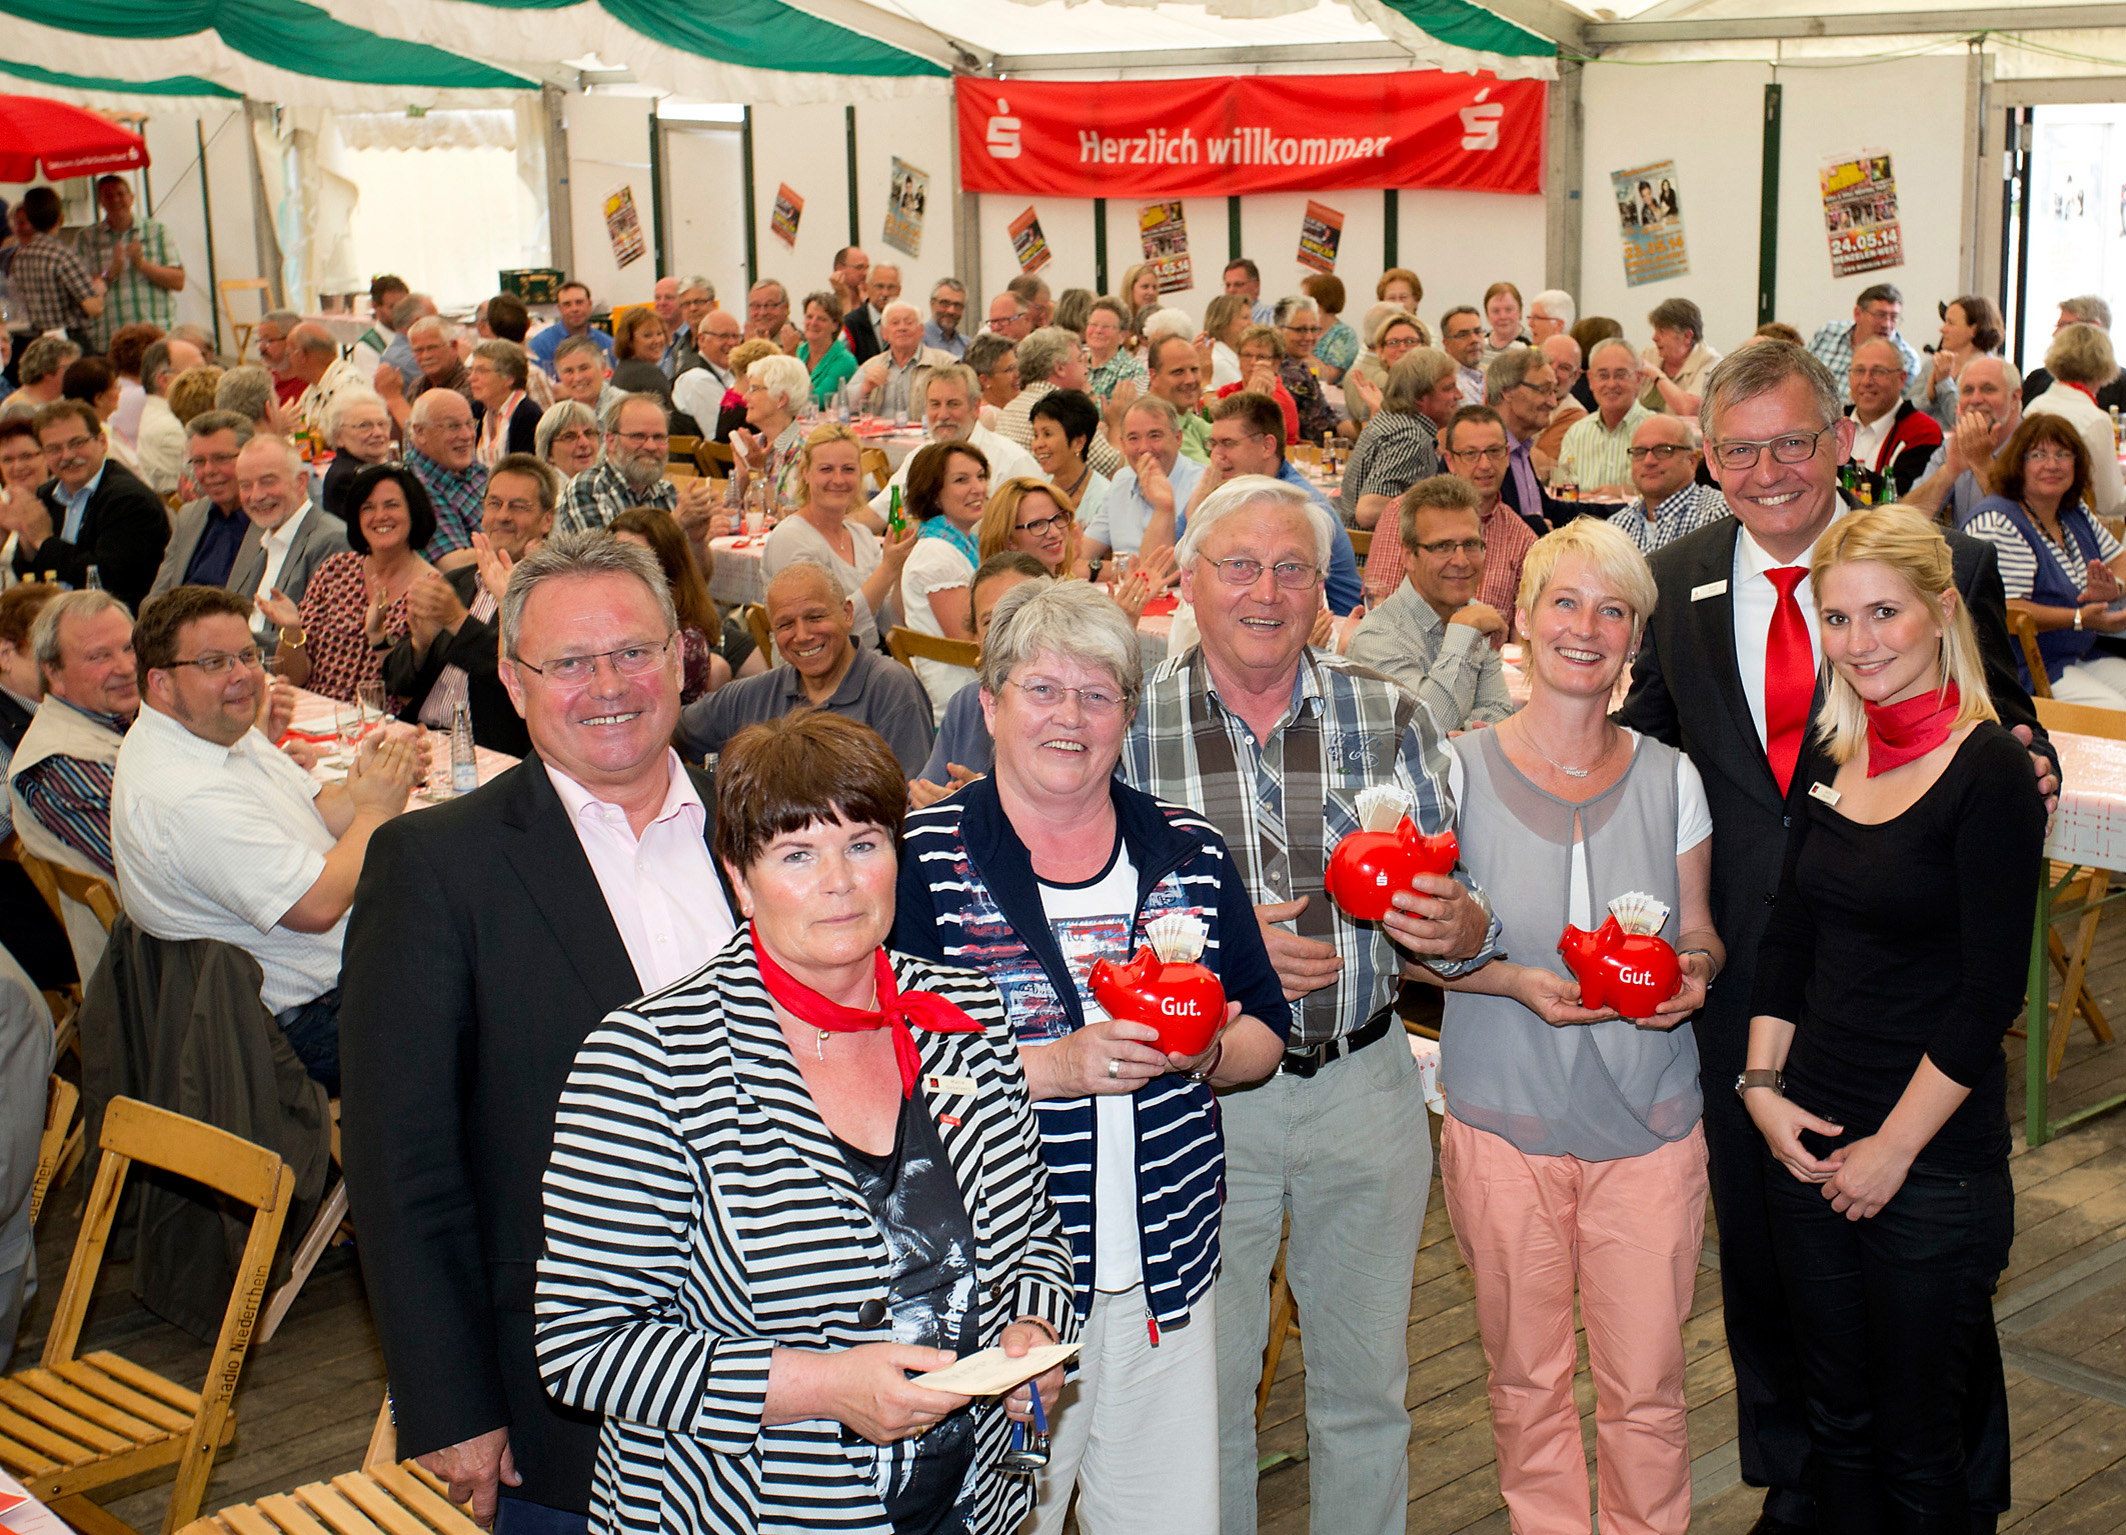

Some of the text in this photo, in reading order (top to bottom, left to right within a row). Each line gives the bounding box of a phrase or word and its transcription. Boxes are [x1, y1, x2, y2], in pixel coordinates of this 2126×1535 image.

[1078, 127, 1198, 164] Herzlich
[1624, 235, 1685, 260] 23.05.14
[1831, 228, 1898, 257] 24.05.14
[1619, 966, 1656, 987] Gut.
[1161, 997, 1202, 1017] Gut.
[230, 1265, 267, 1352] Niederrhein
